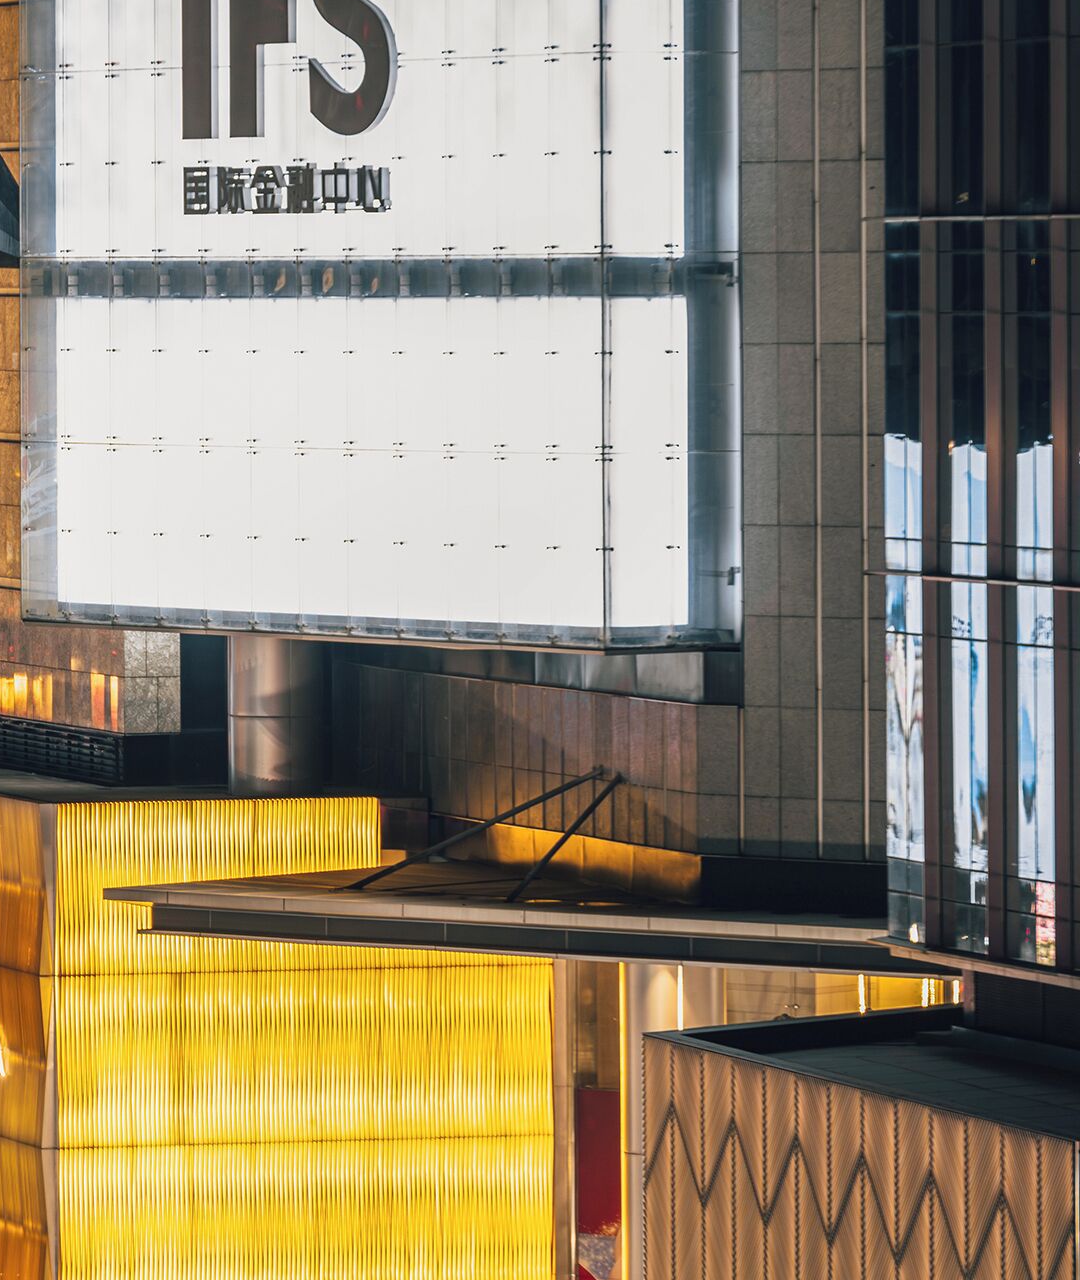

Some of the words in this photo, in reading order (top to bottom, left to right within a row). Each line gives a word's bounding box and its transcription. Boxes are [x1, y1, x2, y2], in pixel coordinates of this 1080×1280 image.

[183, 164, 392, 214] 国际金融中心
